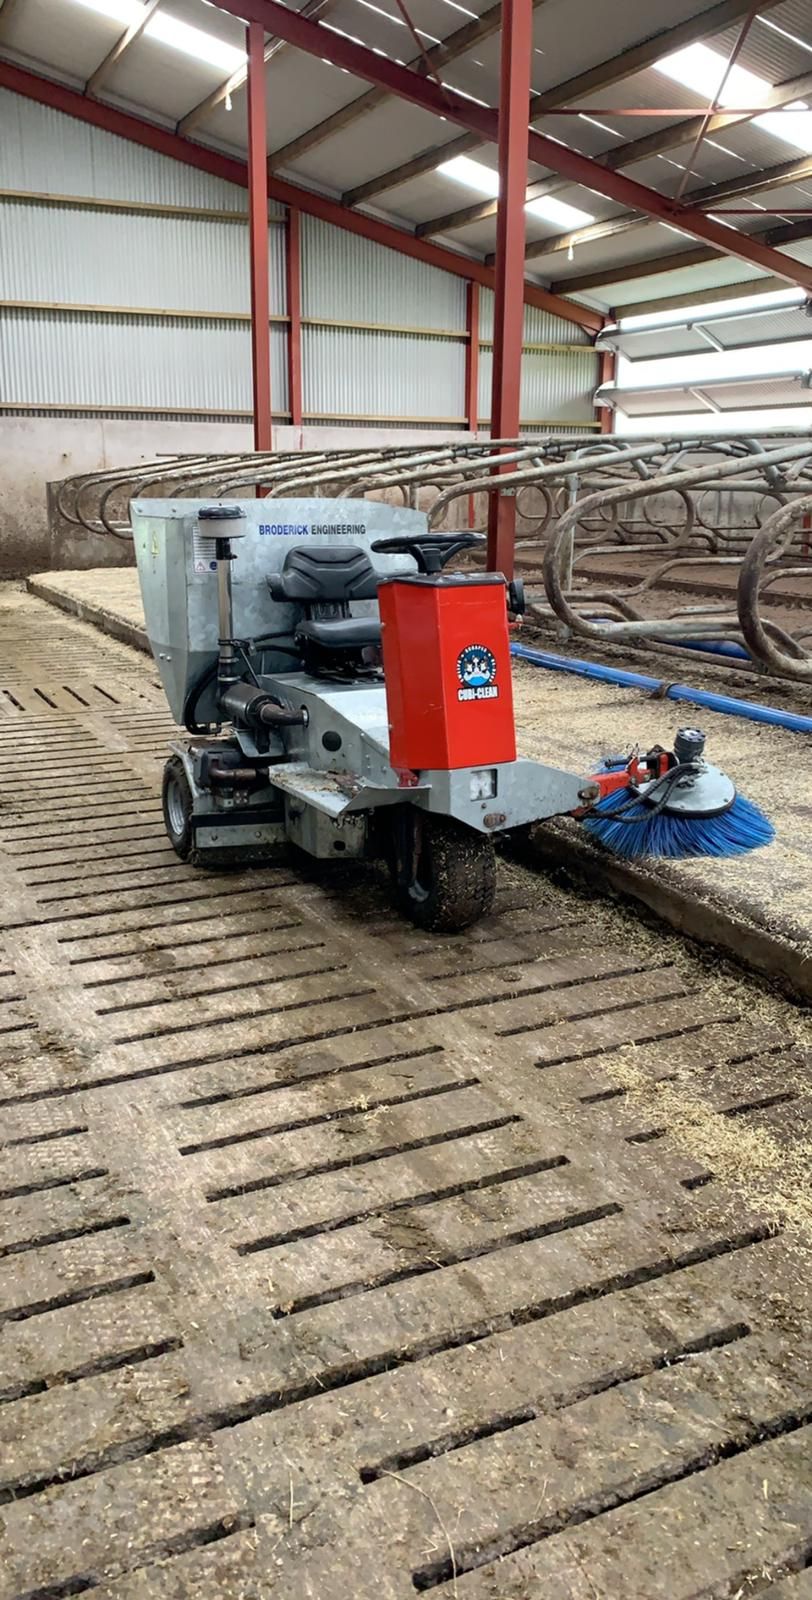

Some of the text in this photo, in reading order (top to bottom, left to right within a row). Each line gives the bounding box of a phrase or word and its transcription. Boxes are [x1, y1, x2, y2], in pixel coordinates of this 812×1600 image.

[258, 524, 366, 536] BRODERICK ENGINEERING
[457, 686, 498, 701] CUBI-CLEAN
